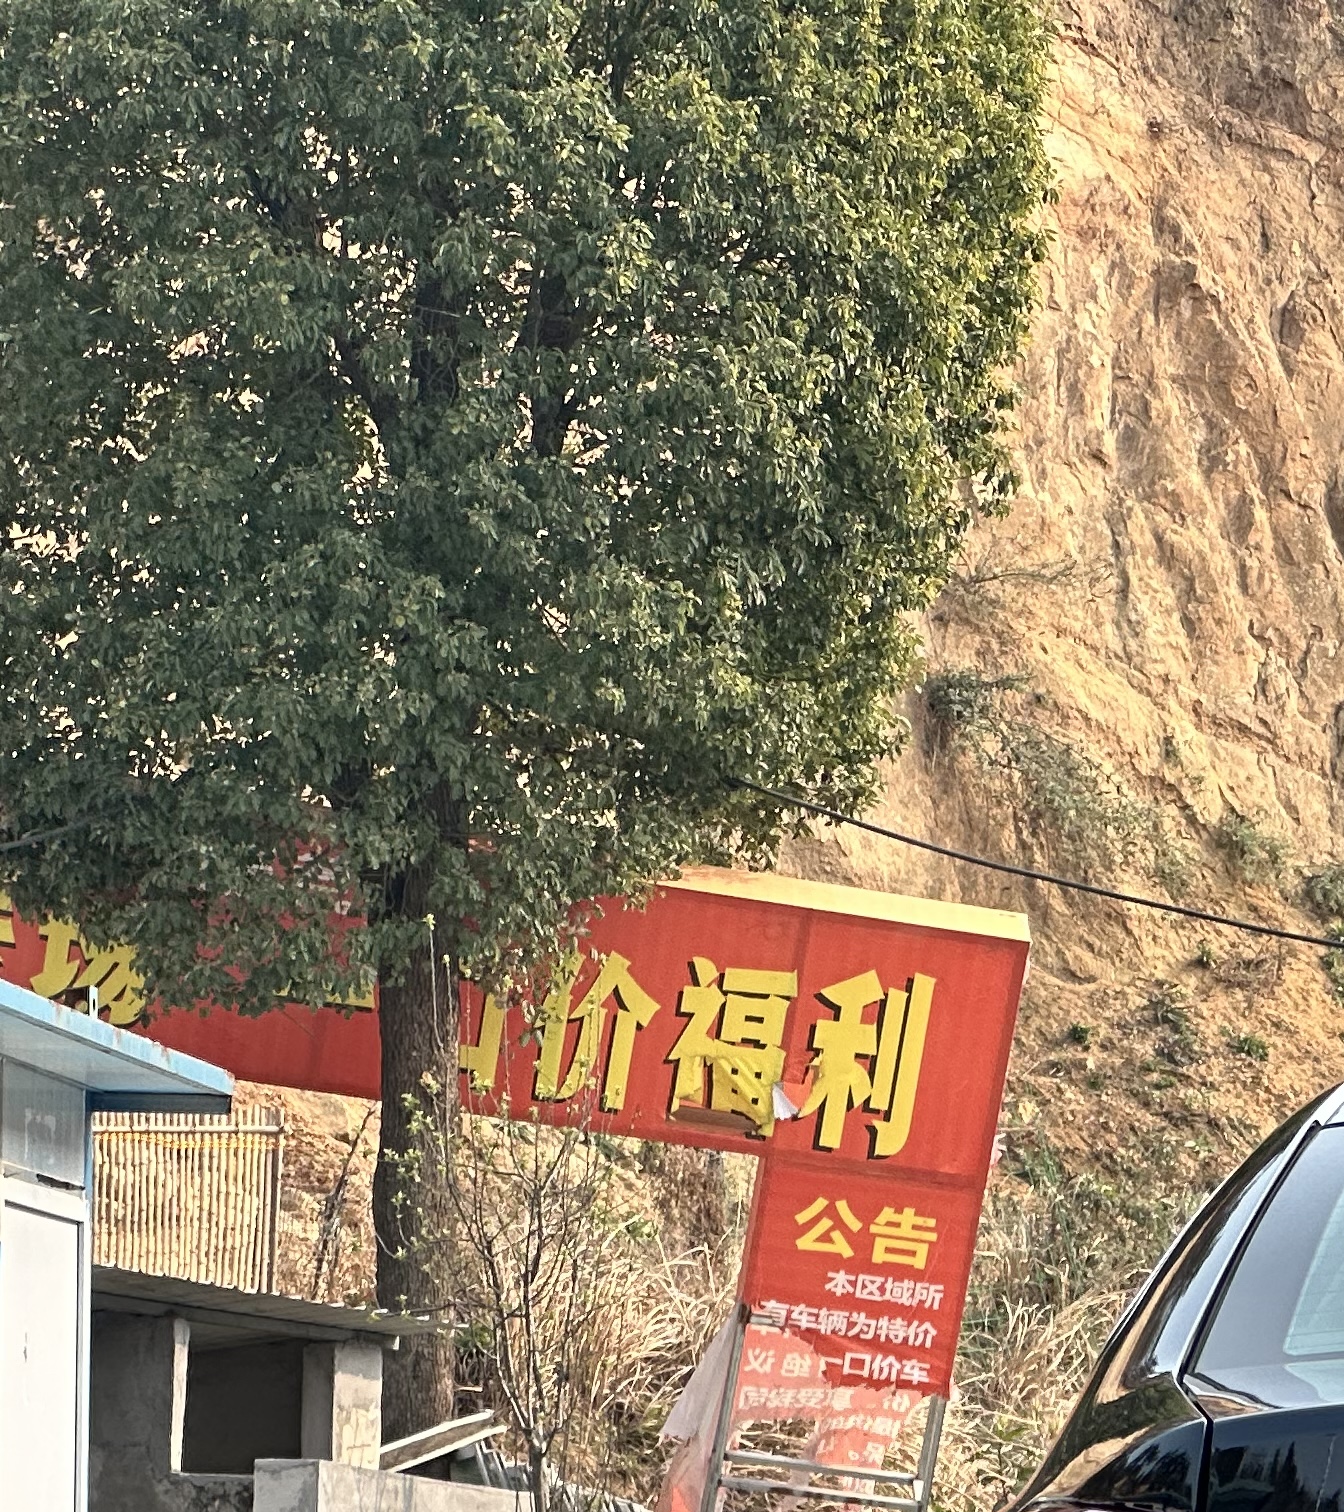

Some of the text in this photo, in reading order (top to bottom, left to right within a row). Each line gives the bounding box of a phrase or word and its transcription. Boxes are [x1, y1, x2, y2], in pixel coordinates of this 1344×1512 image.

[794, 1196, 938, 1270] 公告
[824, 1269, 945, 1311] 本区域所
